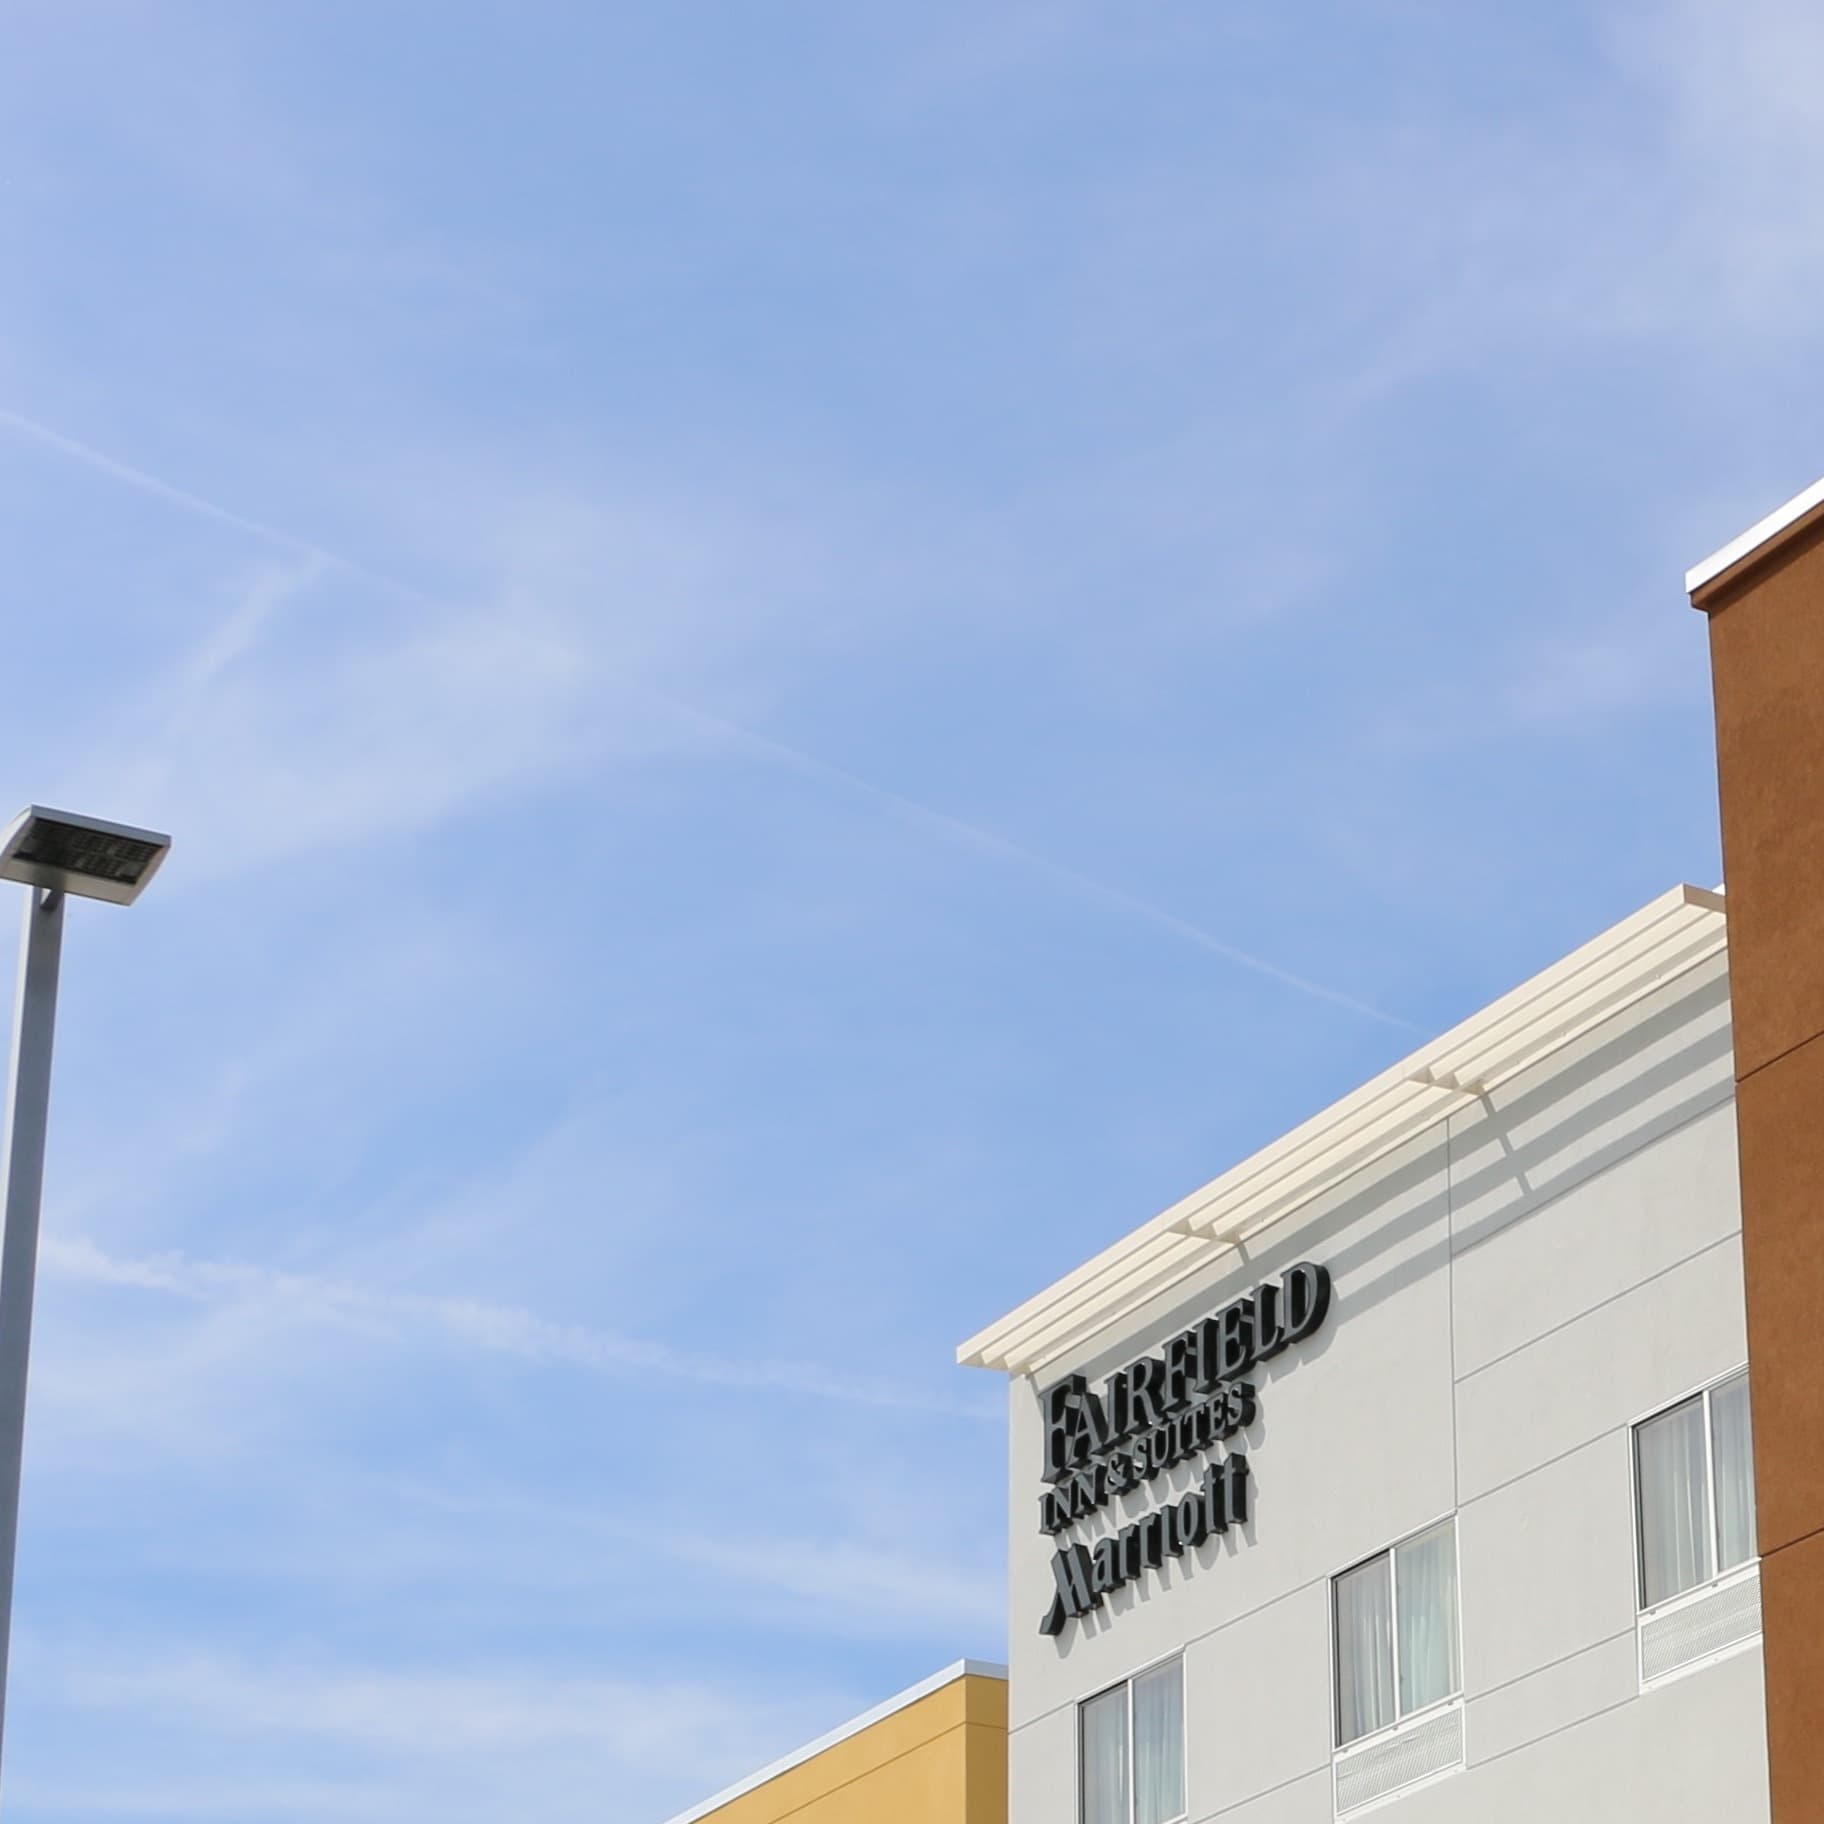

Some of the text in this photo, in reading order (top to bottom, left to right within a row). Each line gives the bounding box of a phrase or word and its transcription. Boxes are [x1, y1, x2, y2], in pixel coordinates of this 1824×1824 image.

[1038, 1261, 1331, 1484] FAIRFIELD
[1038, 1380, 1257, 1535] INN & SUITES
[1038, 1452, 1249, 1636] Marriott
